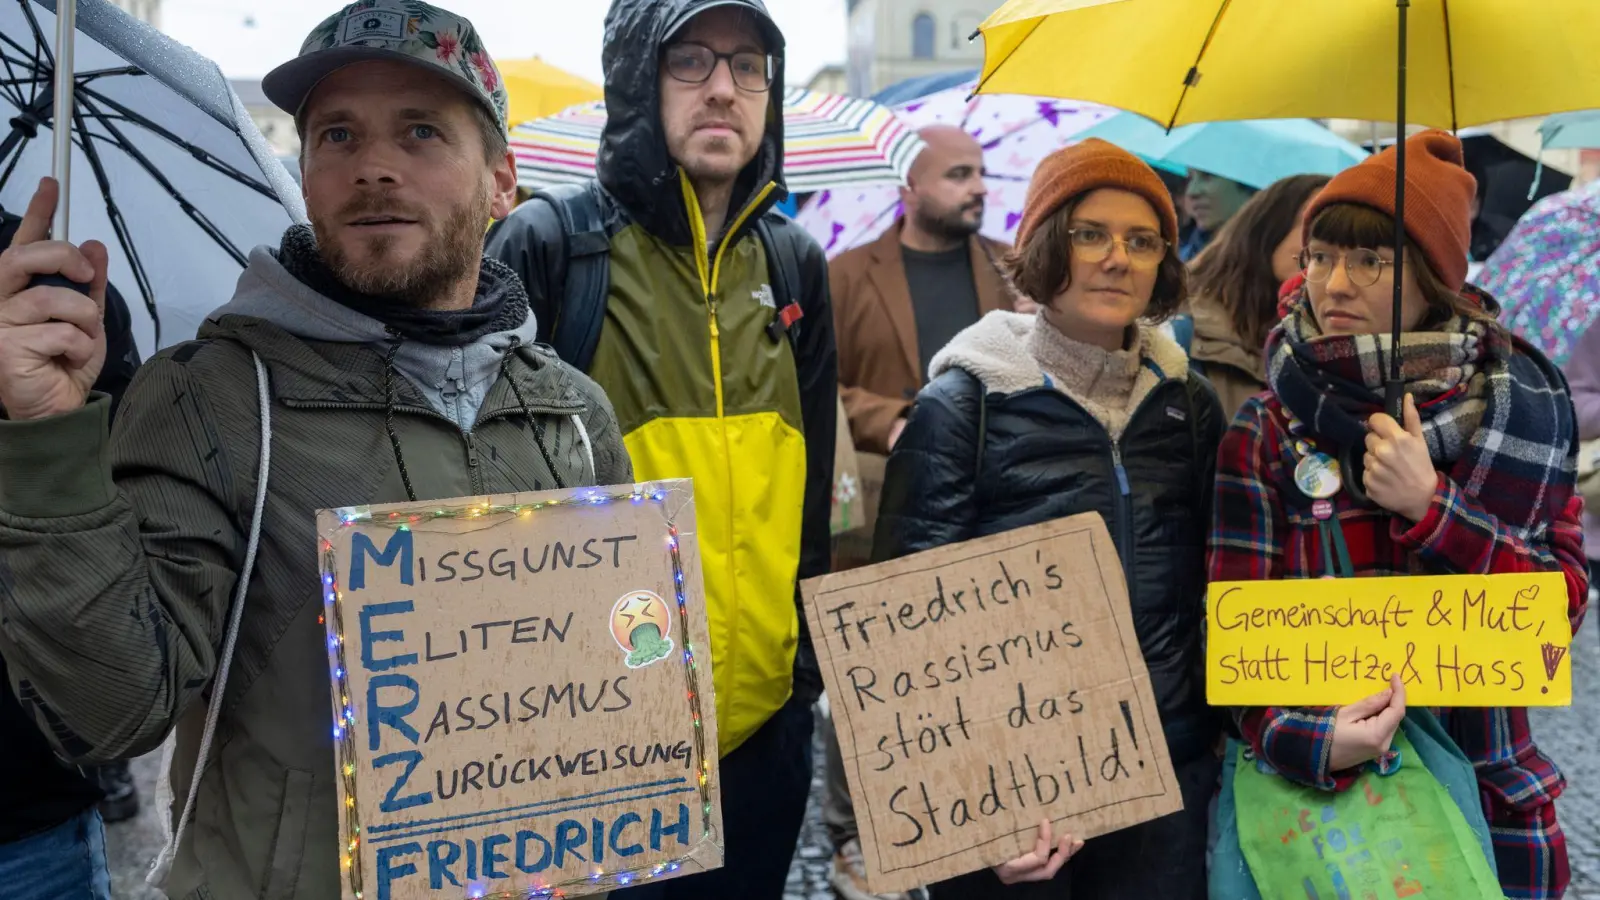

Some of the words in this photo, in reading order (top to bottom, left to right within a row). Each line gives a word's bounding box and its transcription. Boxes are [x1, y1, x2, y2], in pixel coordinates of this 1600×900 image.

[348, 525, 637, 592] MISSGUNST
[358, 600, 574, 672] ELITEN
[826, 549, 1063, 651] Friedrich's
[1216, 587, 1413, 638] Gemeinschaft
[1426, 589, 1452, 626] &
[1463, 588, 1545, 637] Mut,
[847, 621, 1084, 711] Rassismus
[1219, 644, 1291, 684] statt
[1304, 640, 1392, 685] Hetze
[1400, 641, 1422, 685] &
[367, 674, 632, 751] RASSISMUS
[874, 696, 971, 772] stört
[1008, 682, 1084, 729] das
[372, 740, 692, 813] ZURÜCKWEISUNG
[889, 700, 1145, 847] Stadtbild!
[376, 803, 690, 900] FRIEDRICH
